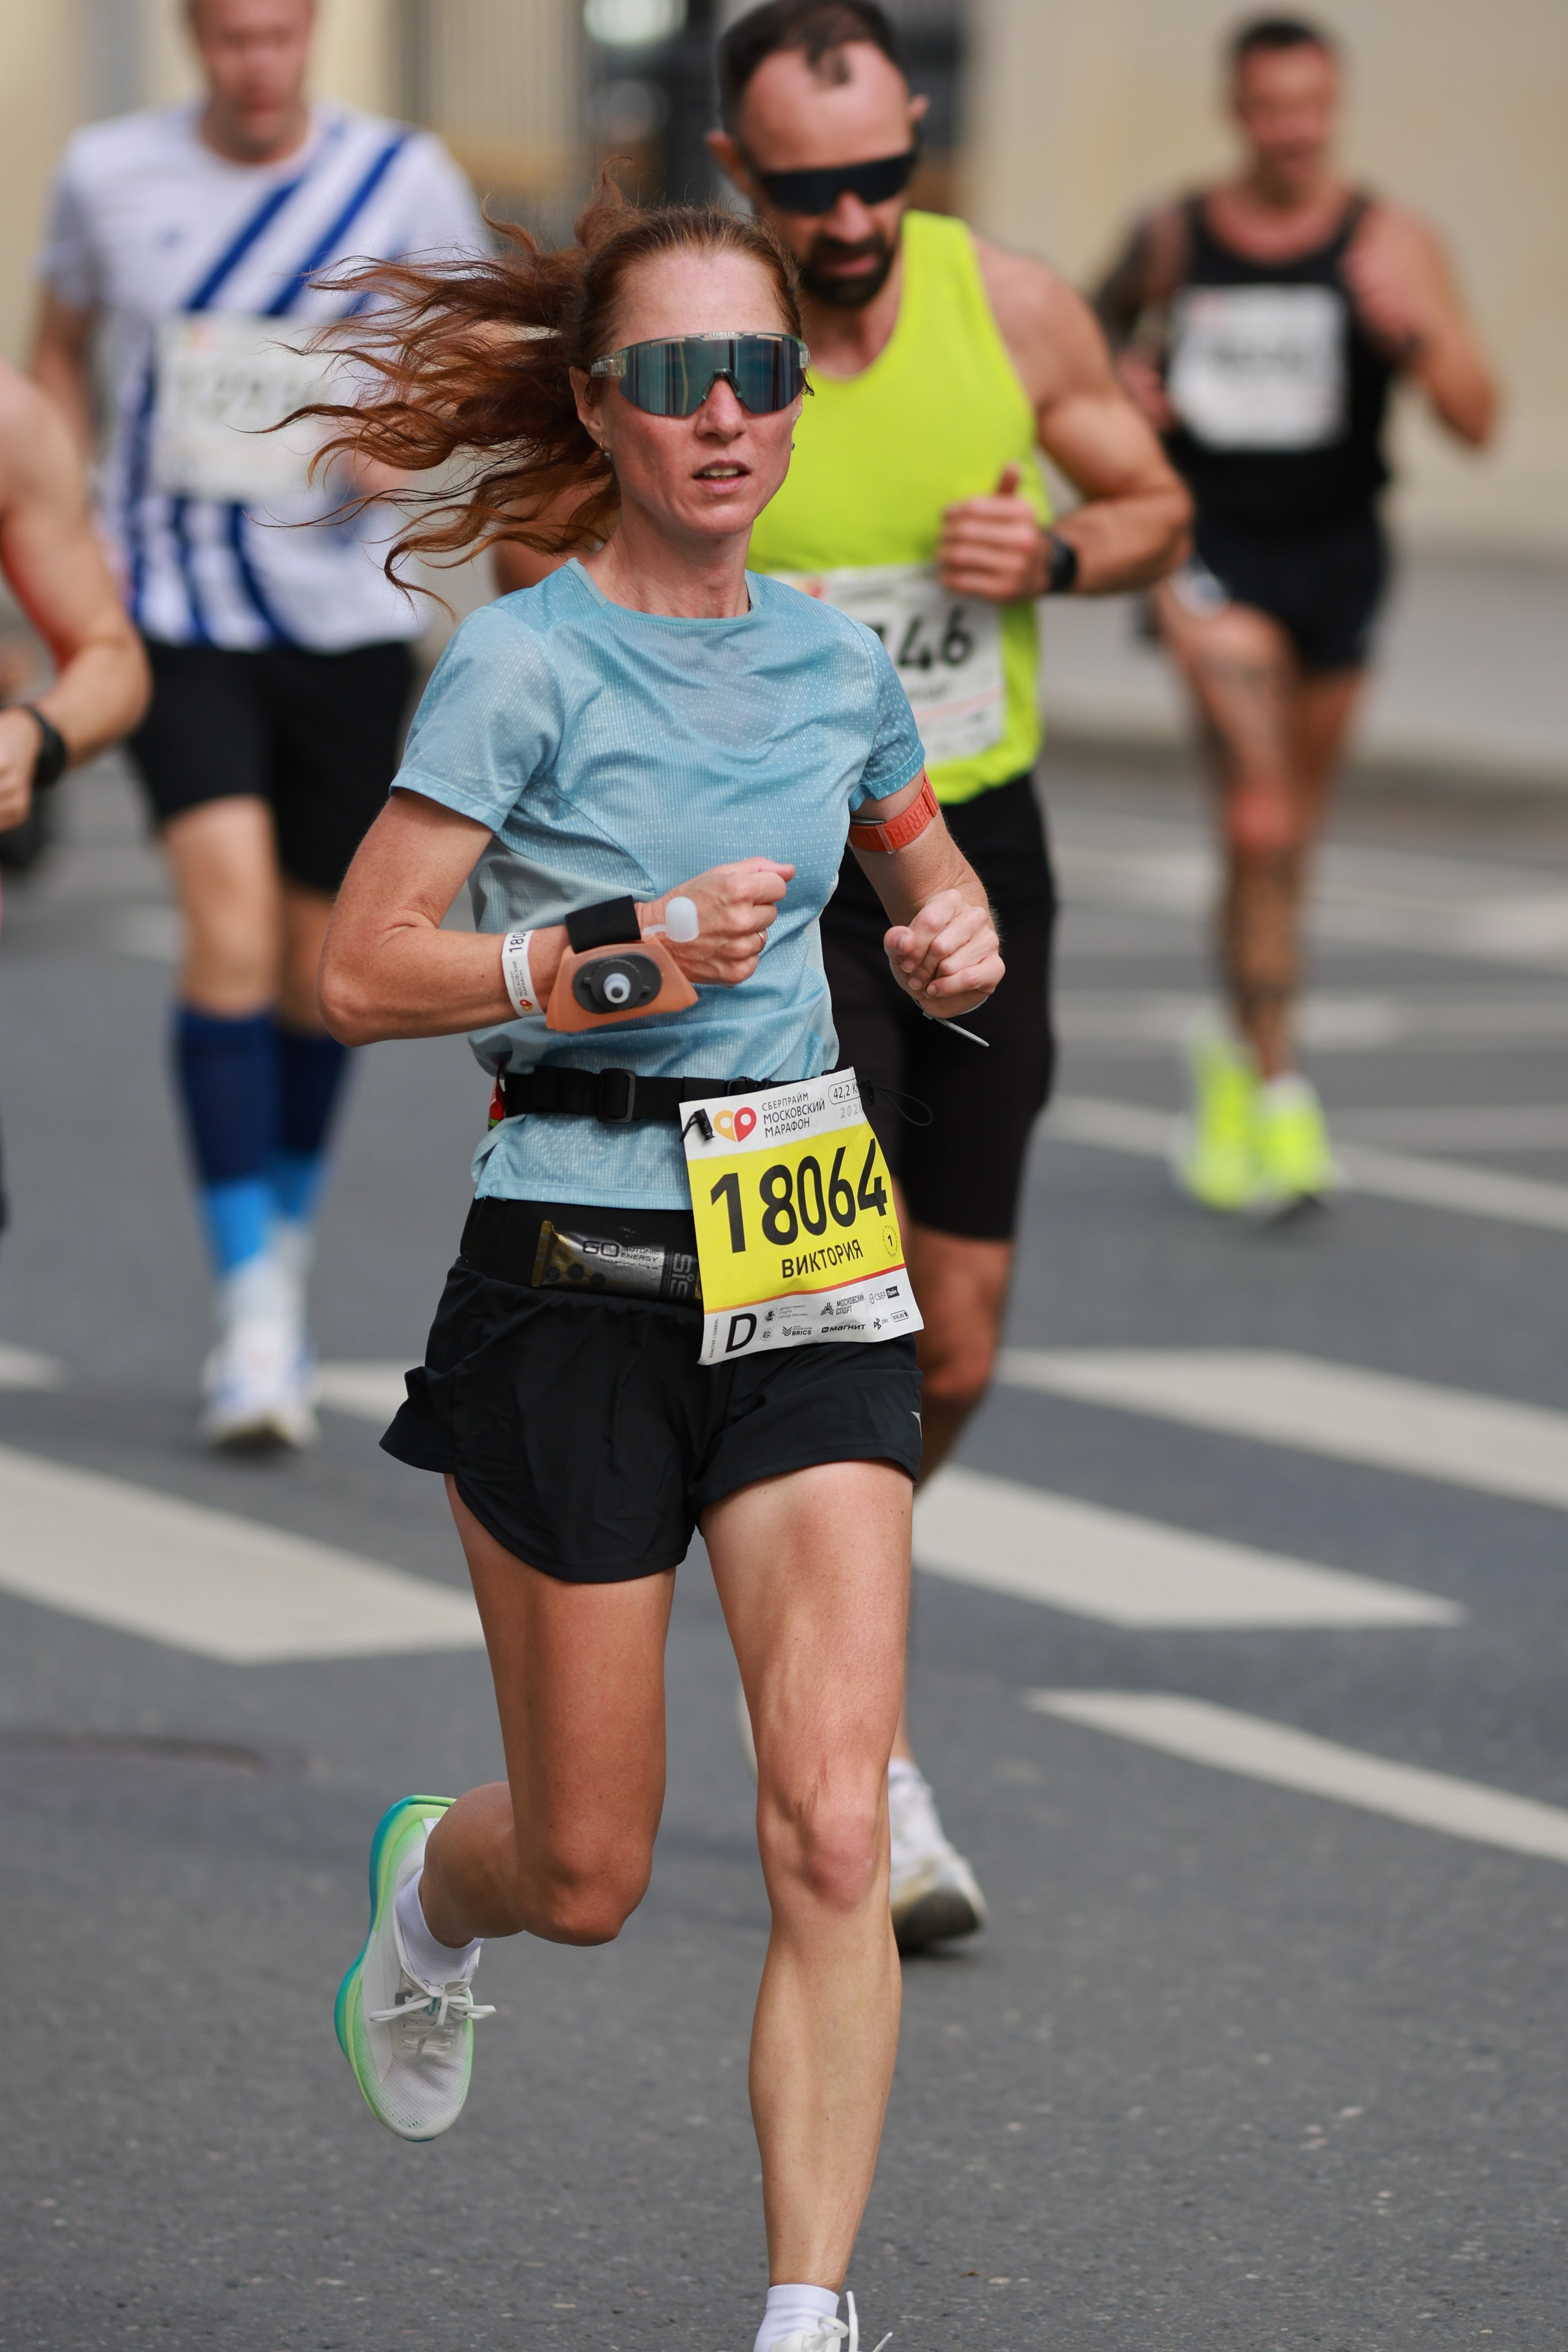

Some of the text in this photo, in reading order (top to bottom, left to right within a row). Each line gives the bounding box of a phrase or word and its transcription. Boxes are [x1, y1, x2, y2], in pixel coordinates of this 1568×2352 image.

[834, 1085, 850, 1099] 42,2
[762, 1092, 809, 1111] СБЕРПРАЙМ
[763, 1098, 825, 1125] МОСКОВСКИЙ
[765, 1117, 810, 1138] МАРАФОН
[710, 1138, 888, 1254] 18064
[582, 1240, 619, 1257] GO
[888, 1235, 892, 1246] 1
[620, 1253, 658, 1262] ENERGY
[782, 1238, 864, 1279] ВИКТОРИЯ
[836, 1292, 865, 1308] МОСКОВСКИЙ
[875, 1291, 886, 1300] СБЕР
[836, 1305, 852, 1315] СПОРТ
[725, 1313, 757, 1354] D
